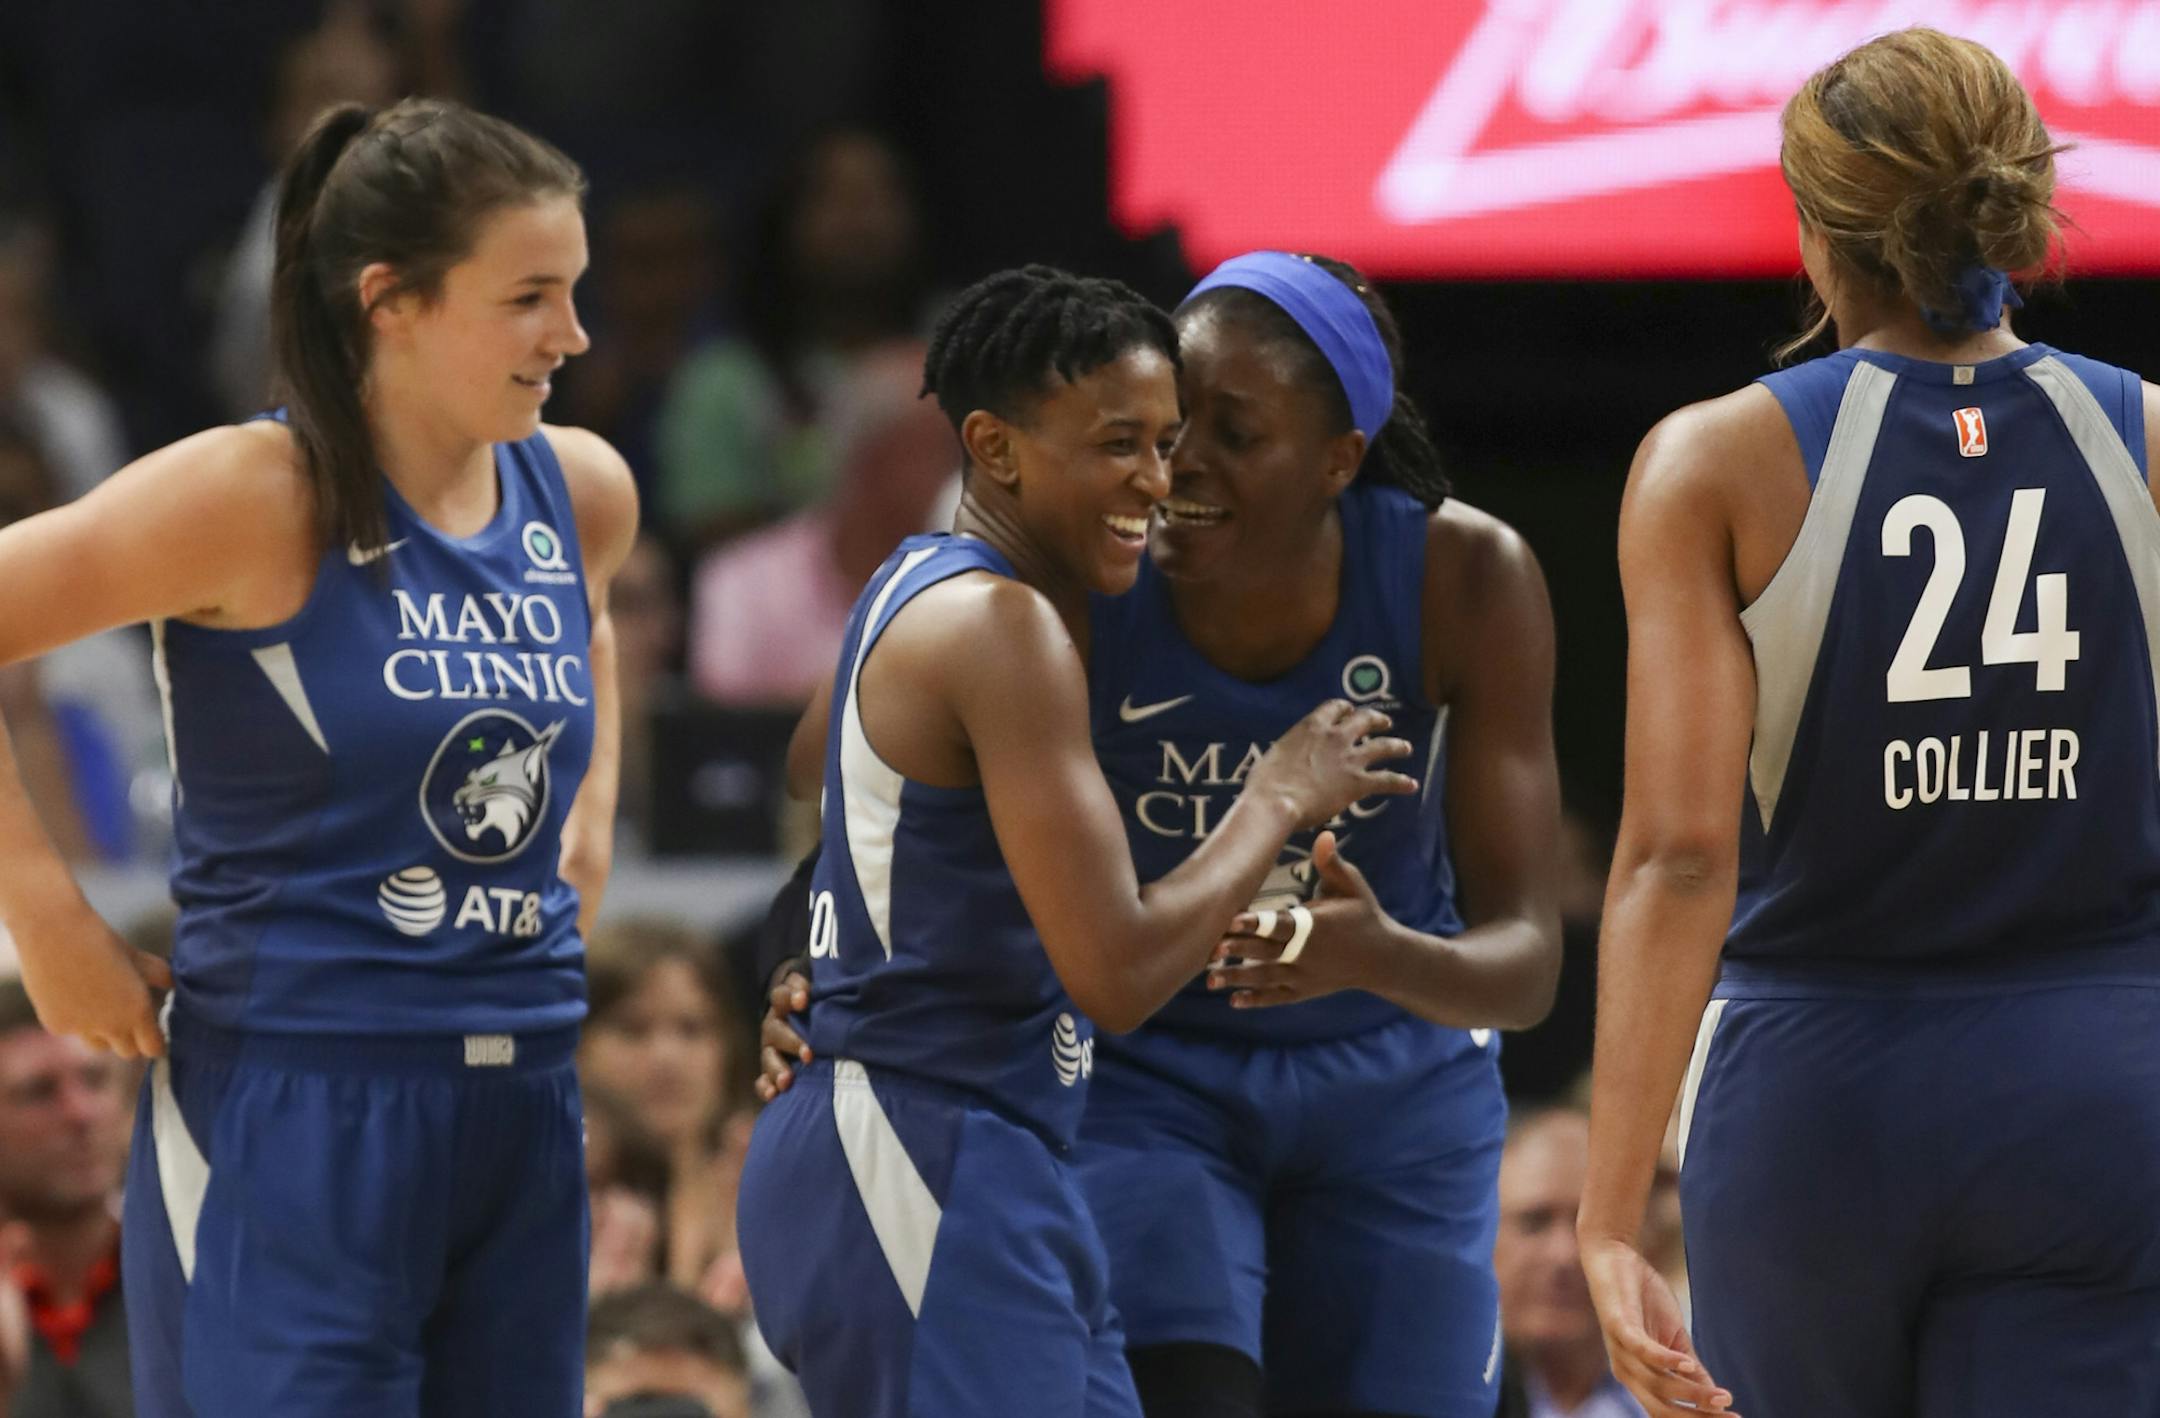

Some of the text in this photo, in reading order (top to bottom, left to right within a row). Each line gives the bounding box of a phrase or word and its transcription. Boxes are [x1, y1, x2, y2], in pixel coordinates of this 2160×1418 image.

[391, 589, 562, 645] MAYO
[1881, 487, 2080, 703] 24
[382, 648, 588, 707] CLINIC
[1883, 728, 2080, 810] COLLIER
